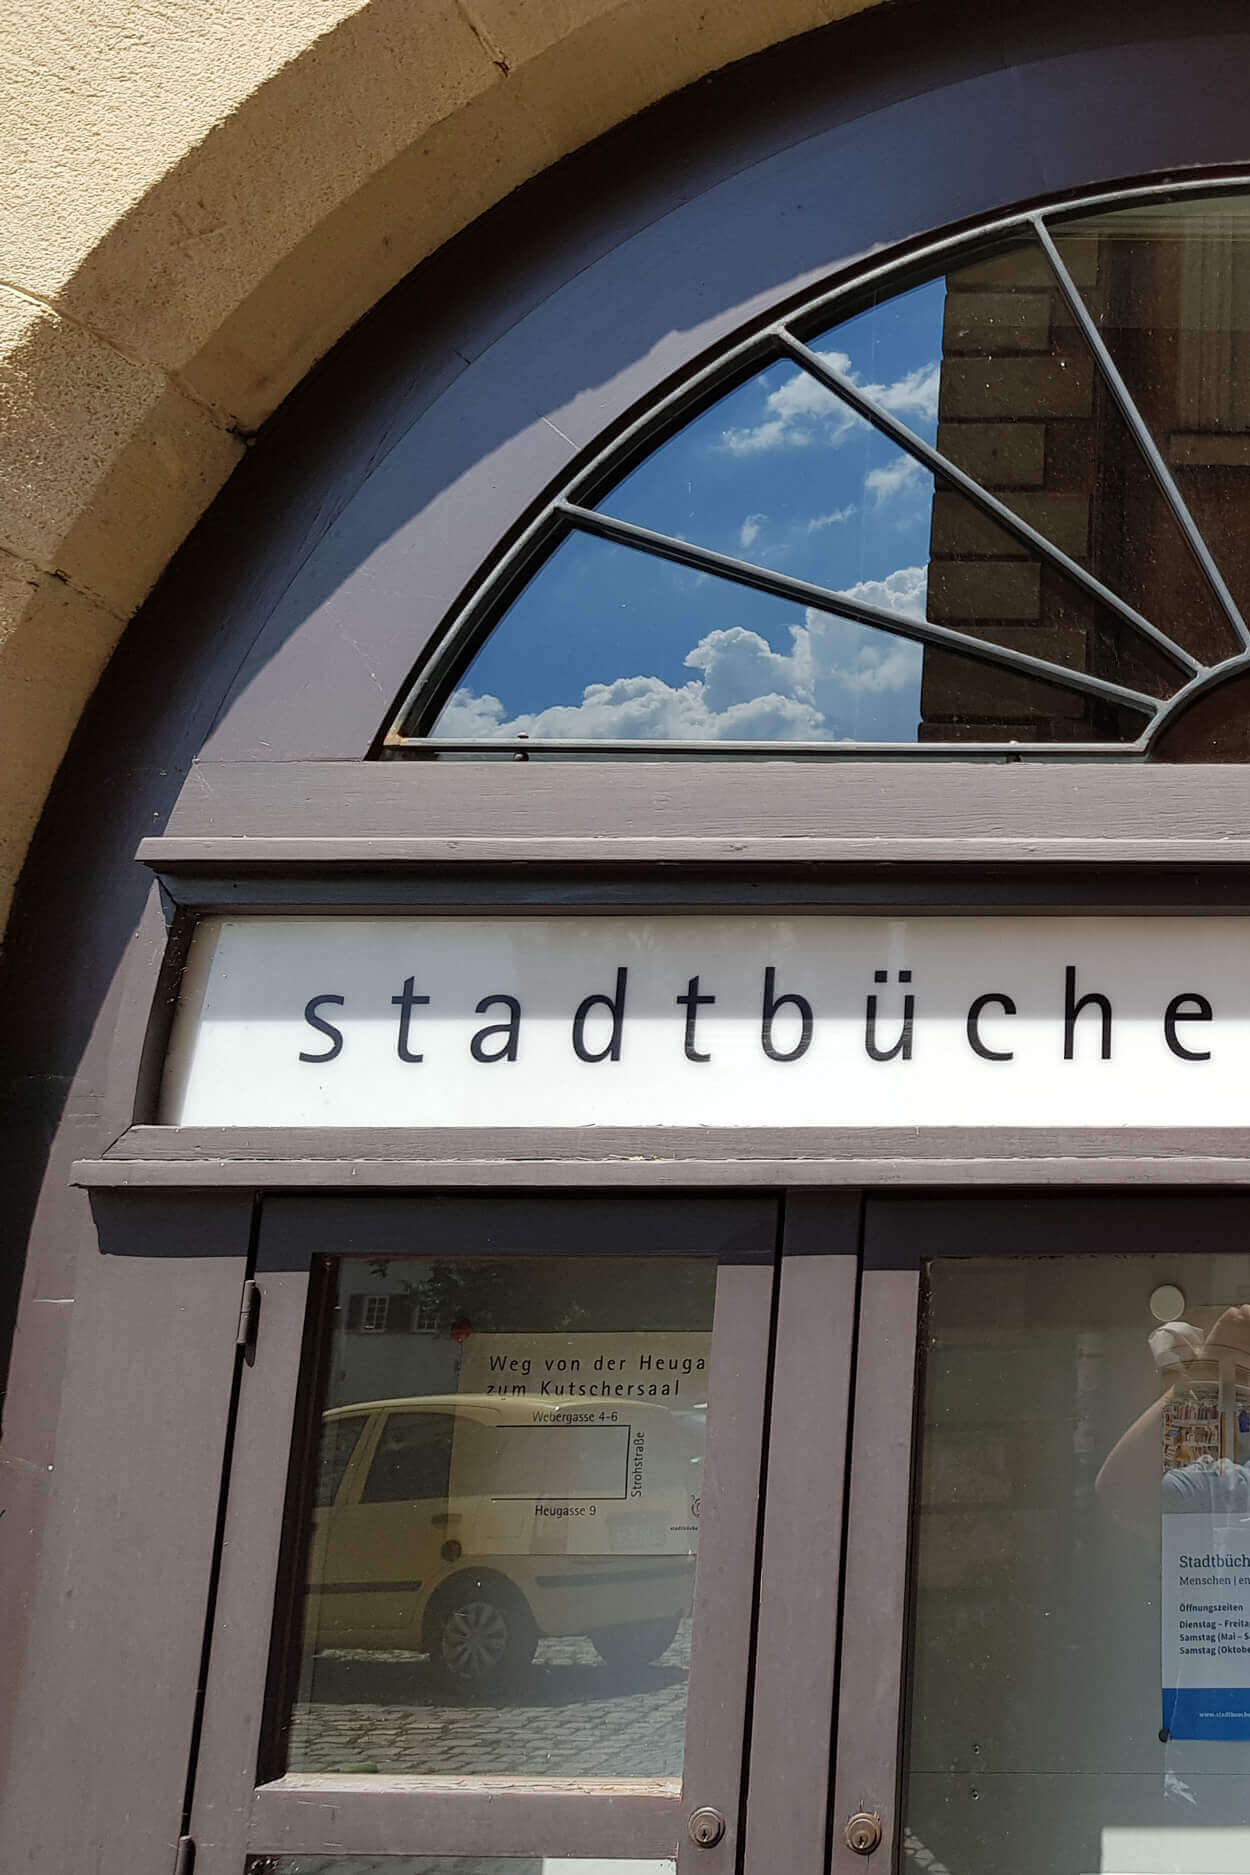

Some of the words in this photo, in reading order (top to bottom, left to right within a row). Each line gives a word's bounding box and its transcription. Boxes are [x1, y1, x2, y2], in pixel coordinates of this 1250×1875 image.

[489, 1355, 532, 1375] Weg
[544, 1358, 581, 1371] von
[593, 1355, 626, 1371] der
[487, 1383, 527, 1397] zum
[540, 1379, 680, 1397] Kutschersaal
[532, 1410, 595, 1425] Webergasse
[598, 1410, 619, 1422] 4-6
[630, 1431, 646, 1498] Strohstraße
[534, 1504, 586, 1519] Heugasse
[588, 1504, 597, 1516] 9
[1178, 1575, 1232, 1586] Menschen
[1178, 1602, 1244, 1614] Öffnungszeiten
[1178, 1620, 1217, 1630] Dienstag
[1178, 1633, 1217, 1643] Samstag
[1178, 1646, 1217, 1656] Samstag
